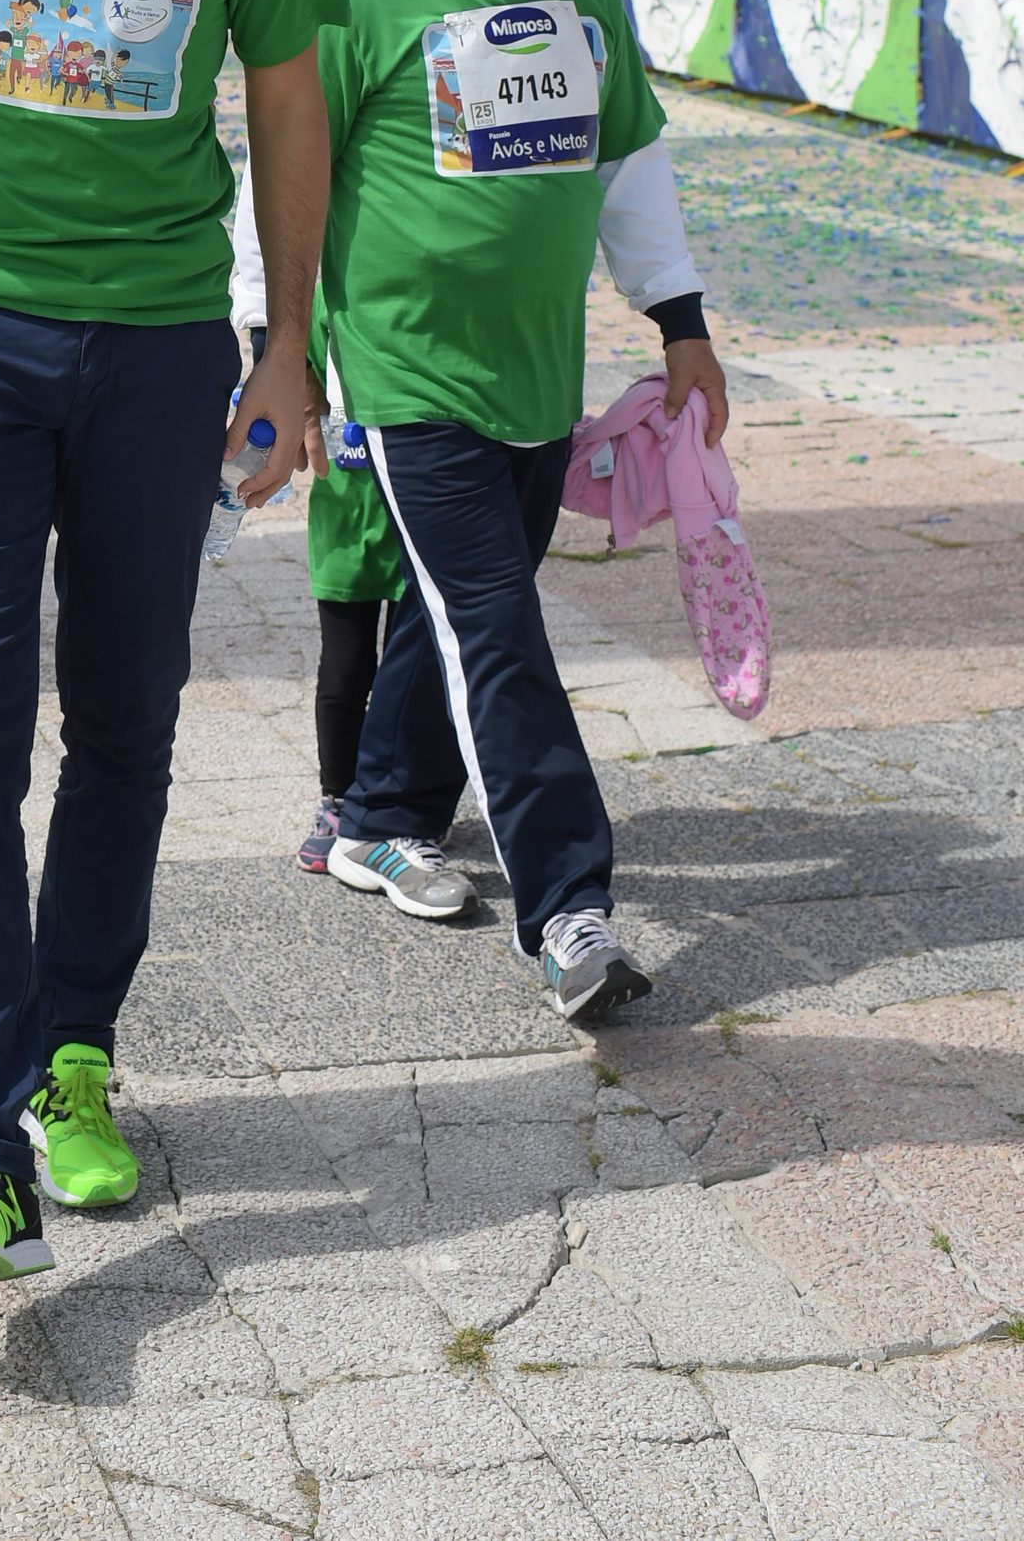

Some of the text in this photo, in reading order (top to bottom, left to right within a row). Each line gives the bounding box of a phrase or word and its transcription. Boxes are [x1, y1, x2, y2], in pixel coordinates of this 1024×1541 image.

[490, 17, 553, 37] Mimosa
[497, 71, 568, 104] 47143
[474, 104, 492, 118] 25
[476, 118, 493, 126] ANOS
[488, 130, 511, 140] Passeio
[491, 133, 588, 160] Avós e Netos
[80, 1057, 107, 1067] balance
